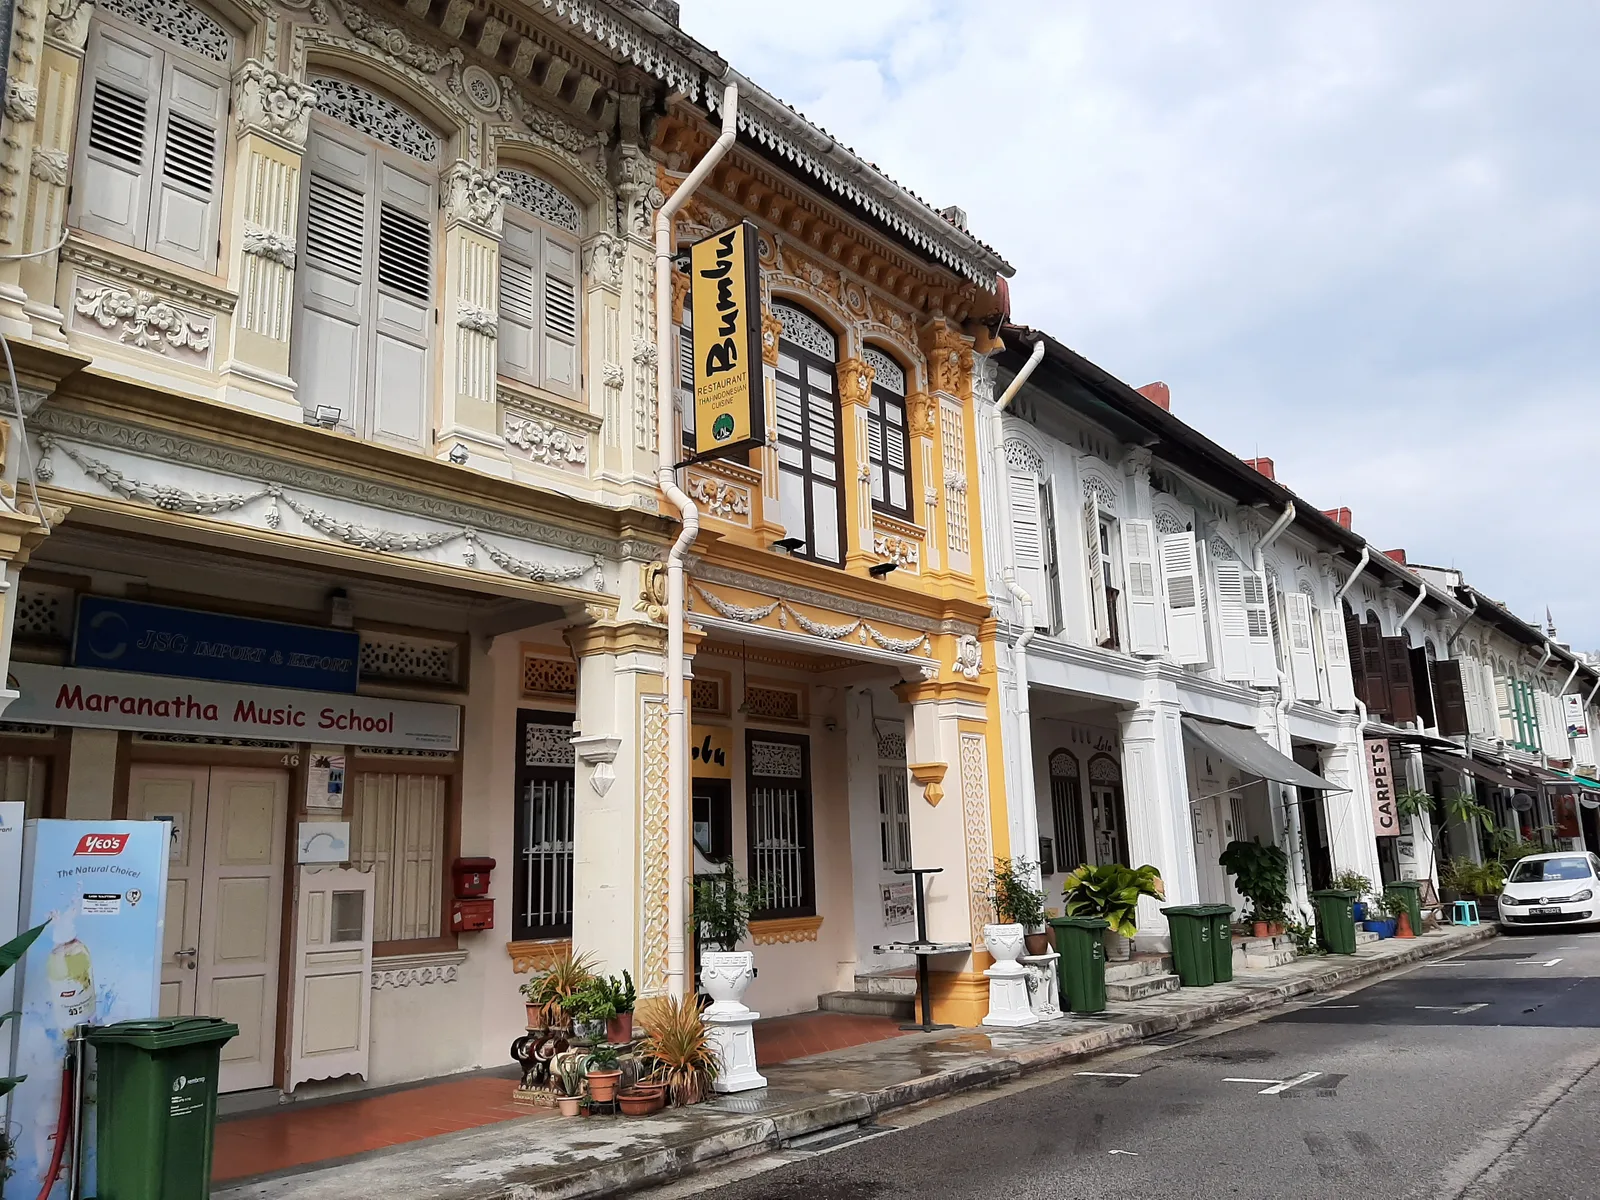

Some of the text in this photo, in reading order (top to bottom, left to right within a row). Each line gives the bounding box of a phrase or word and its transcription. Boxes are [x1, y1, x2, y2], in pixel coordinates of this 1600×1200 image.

[700, 230, 739, 377] Bumbu
[697, 371, 747, 396] RESTAURANT
[711, 396, 734, 410] CUISINE
[136, 629, 352, 673] JSG IMPORT & EXPORT
[55, 683, 394, 733] Maranatha Music School
[280, 754, 300, 767] 46
[1371, 744, 1393, 828] CARPETS
[56, 865, 141, 879] The Natural Choice!
